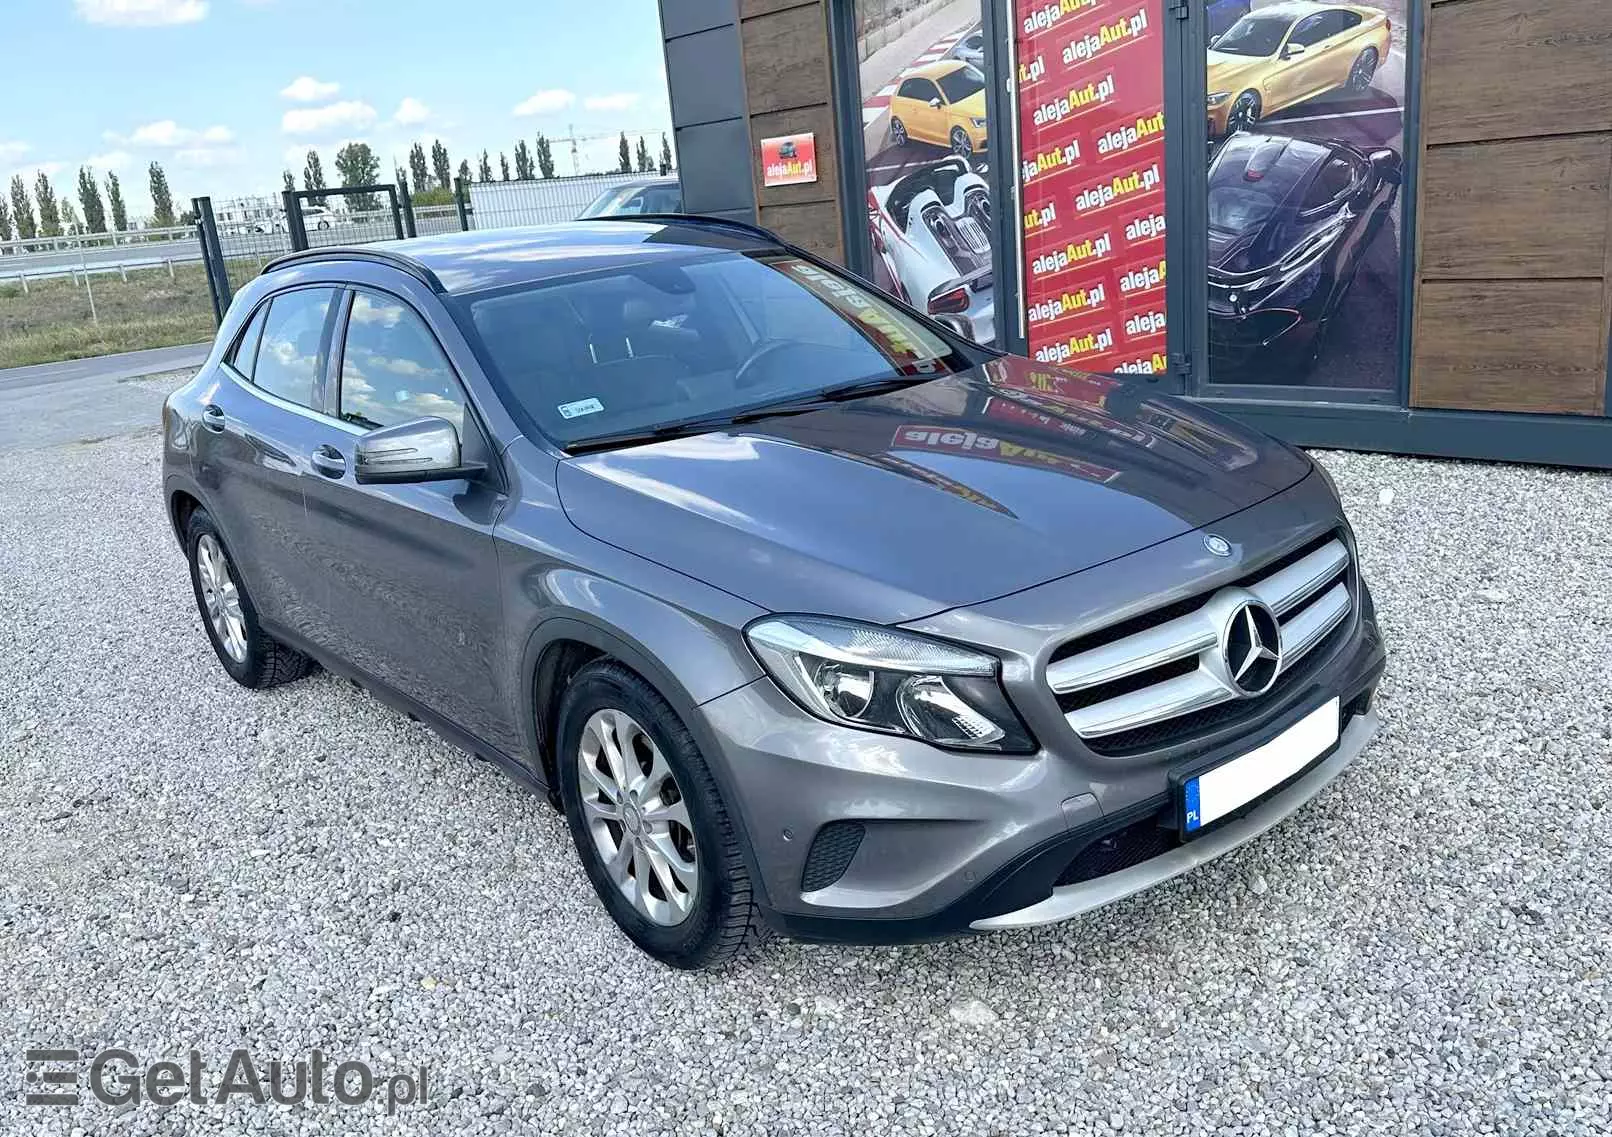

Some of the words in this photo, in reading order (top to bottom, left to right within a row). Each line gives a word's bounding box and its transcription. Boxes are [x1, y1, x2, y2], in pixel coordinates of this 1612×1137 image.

[1062, 8, 1148, 64] alejaAut.pl
[1033, 75, 1114, 125] alejaAut.pl
[1075, 164, 1160, 210] alejaAut.pl
[1125, 214, 1166, 240] aleja
[1032, 233, 1111, 274] alejaAut.pl
[1028, 284, 1105, 321] alejaAut.pl
[1125, 312, 1166, 335] aleja
[1035, 328, 1112, 365] alejaAut.pl
[1114, 353, 1167, 374] lejaA
[1187, 810, 1199, 823] PL
